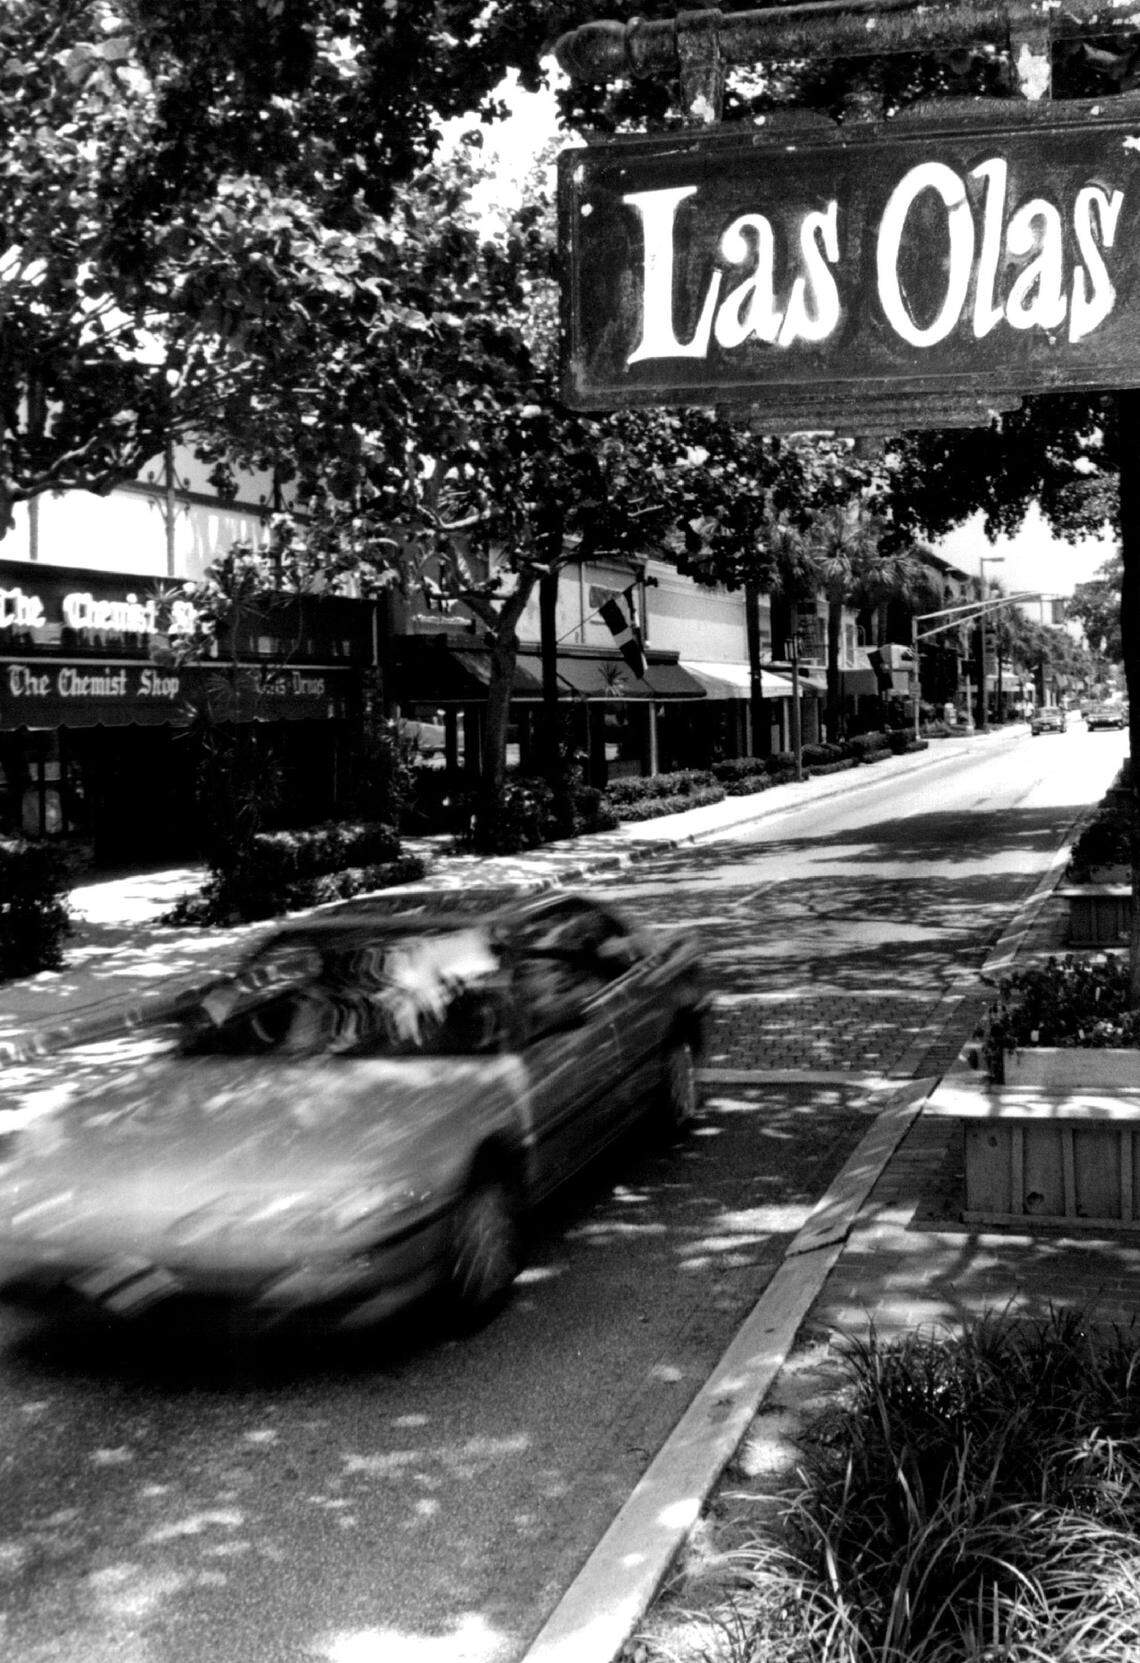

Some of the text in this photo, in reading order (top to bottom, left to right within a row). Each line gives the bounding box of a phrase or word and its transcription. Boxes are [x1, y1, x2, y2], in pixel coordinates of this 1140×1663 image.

[622, 158, 1125, 369] Las Olas
[63, 592, 158, 634] Chemist
[8, 664, 180, 699] The Chemist Shop
